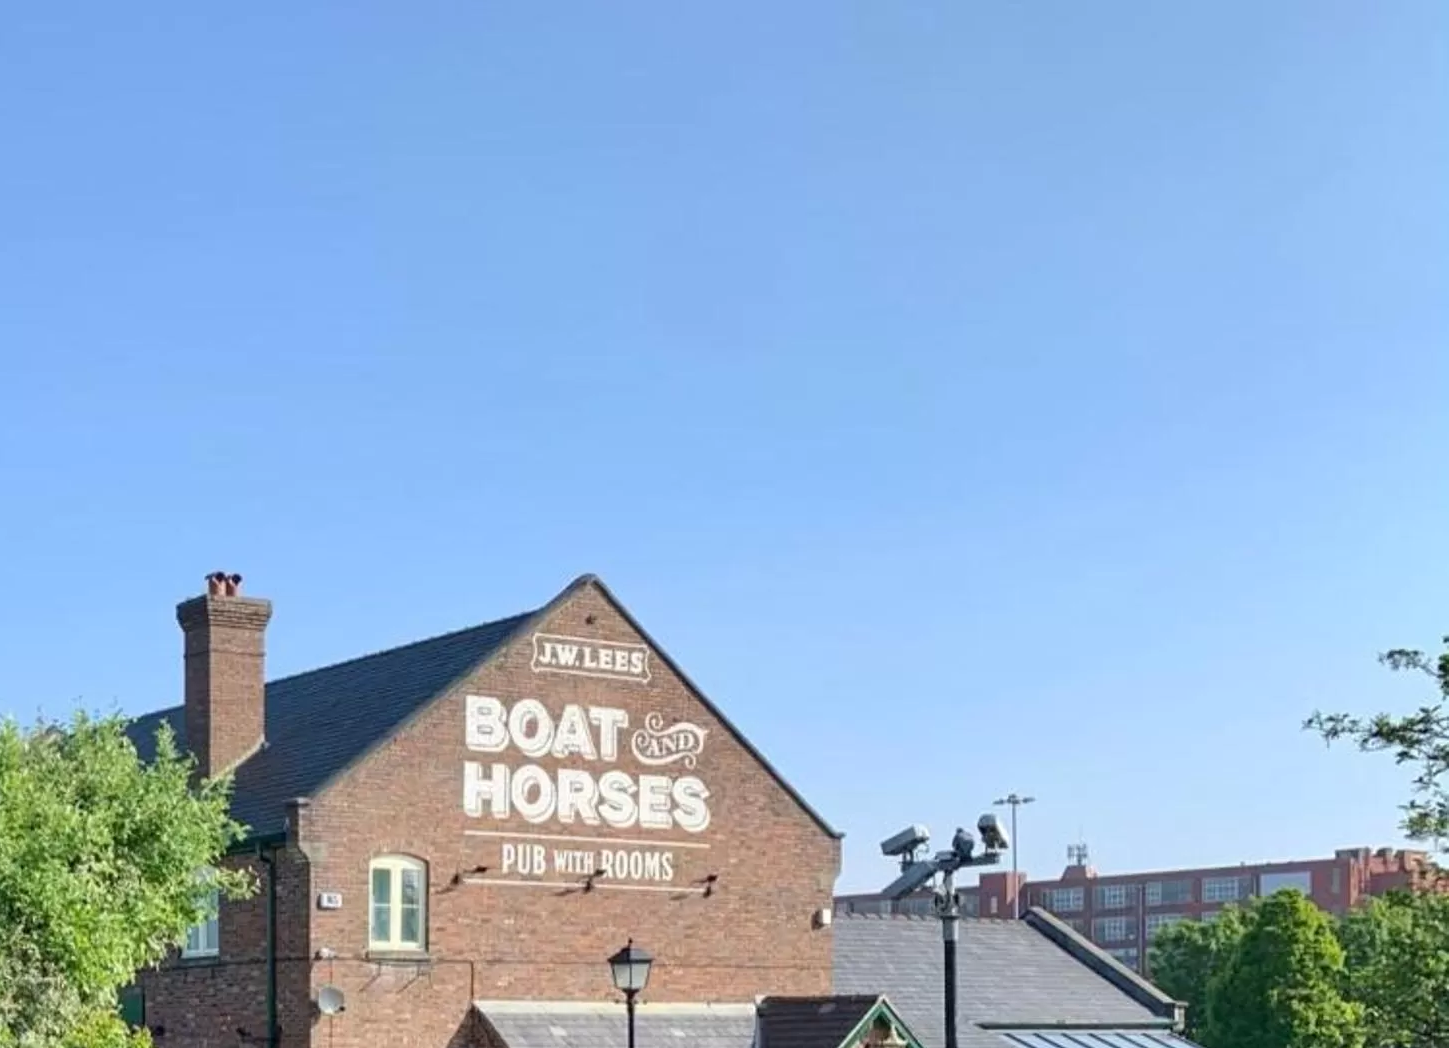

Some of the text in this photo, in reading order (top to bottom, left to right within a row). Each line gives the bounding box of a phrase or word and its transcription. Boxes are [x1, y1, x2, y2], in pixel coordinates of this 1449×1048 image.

[465, 695, 628, 761] BOAT
[463, 761, 711, 833] HORSES
[502, 844, 674, 881] PUB WITH ROOMS
